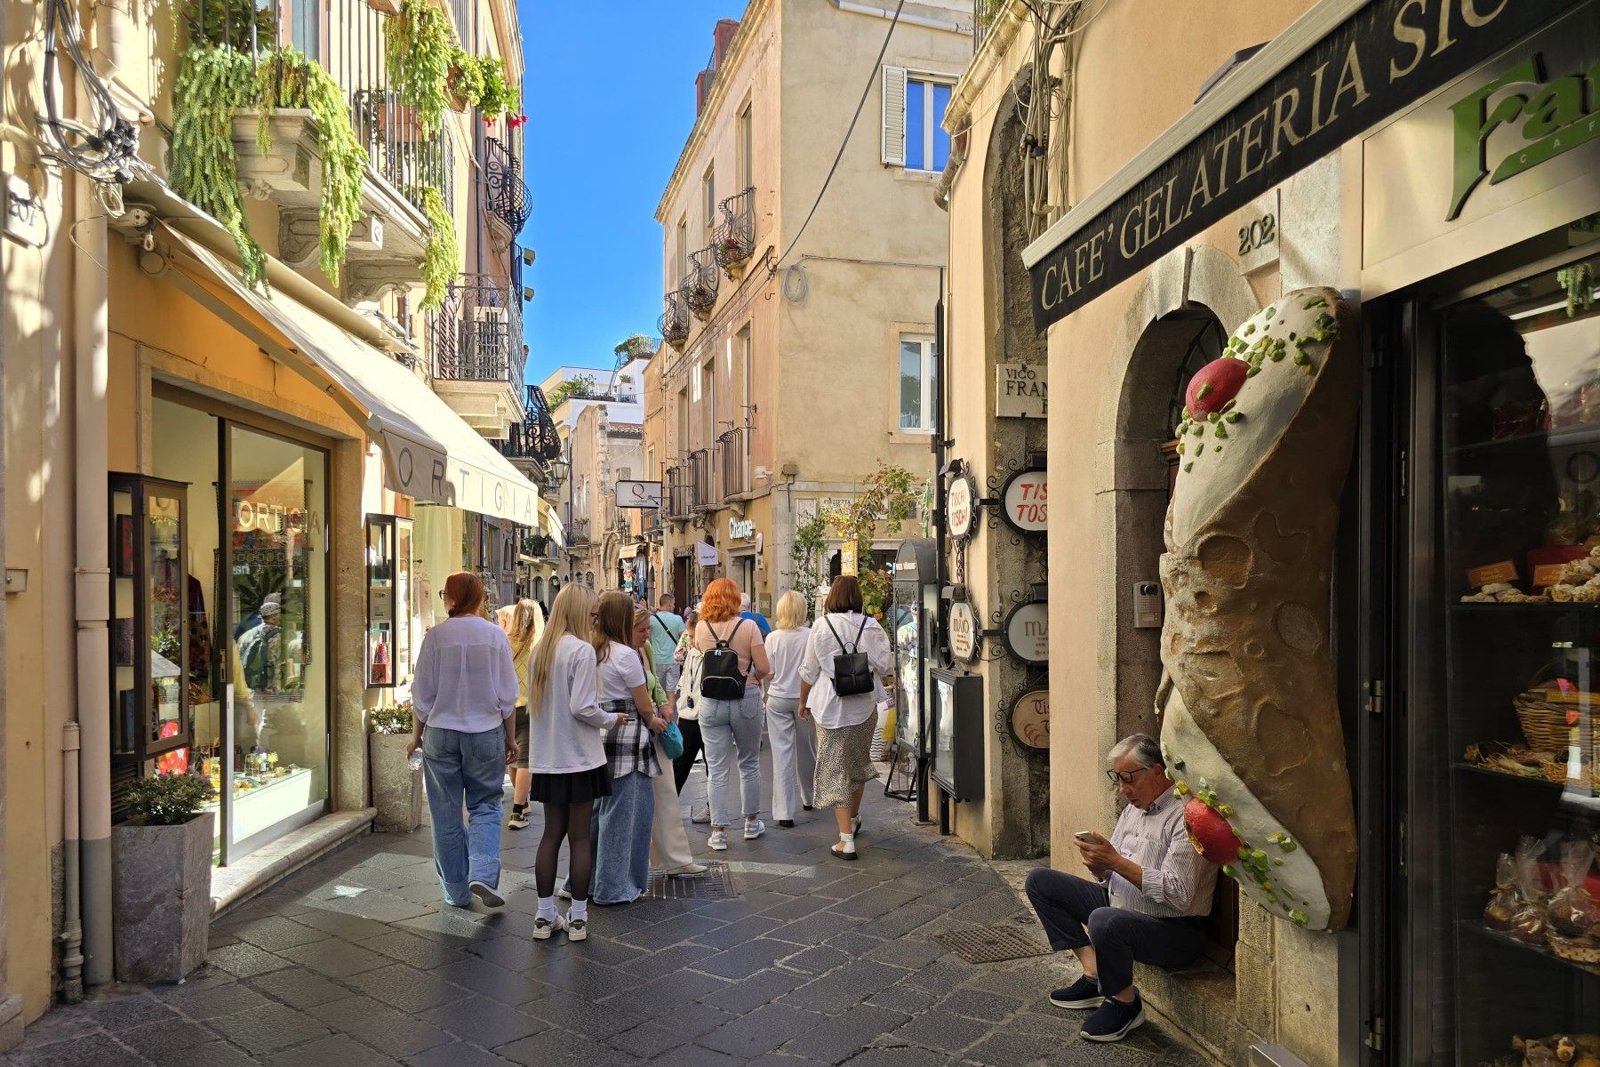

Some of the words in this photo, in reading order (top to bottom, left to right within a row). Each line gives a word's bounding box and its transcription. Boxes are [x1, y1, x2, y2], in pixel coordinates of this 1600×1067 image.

[1444, 52, 1600, 222] Fa
[1041, 223, 1114, 311] CAFE'
[1119, 40, 1371, 260] GELATERIA
[1238, 213, 1275, 256] 202
[1005, 368, 1036, 380] VICO
[398, 447, 532, 521] ORTIGIA
[632, 483, 645, 500] Q
[238, 500, 321, 536] ORTIGIA
[729, 517, 753, 542] Change
